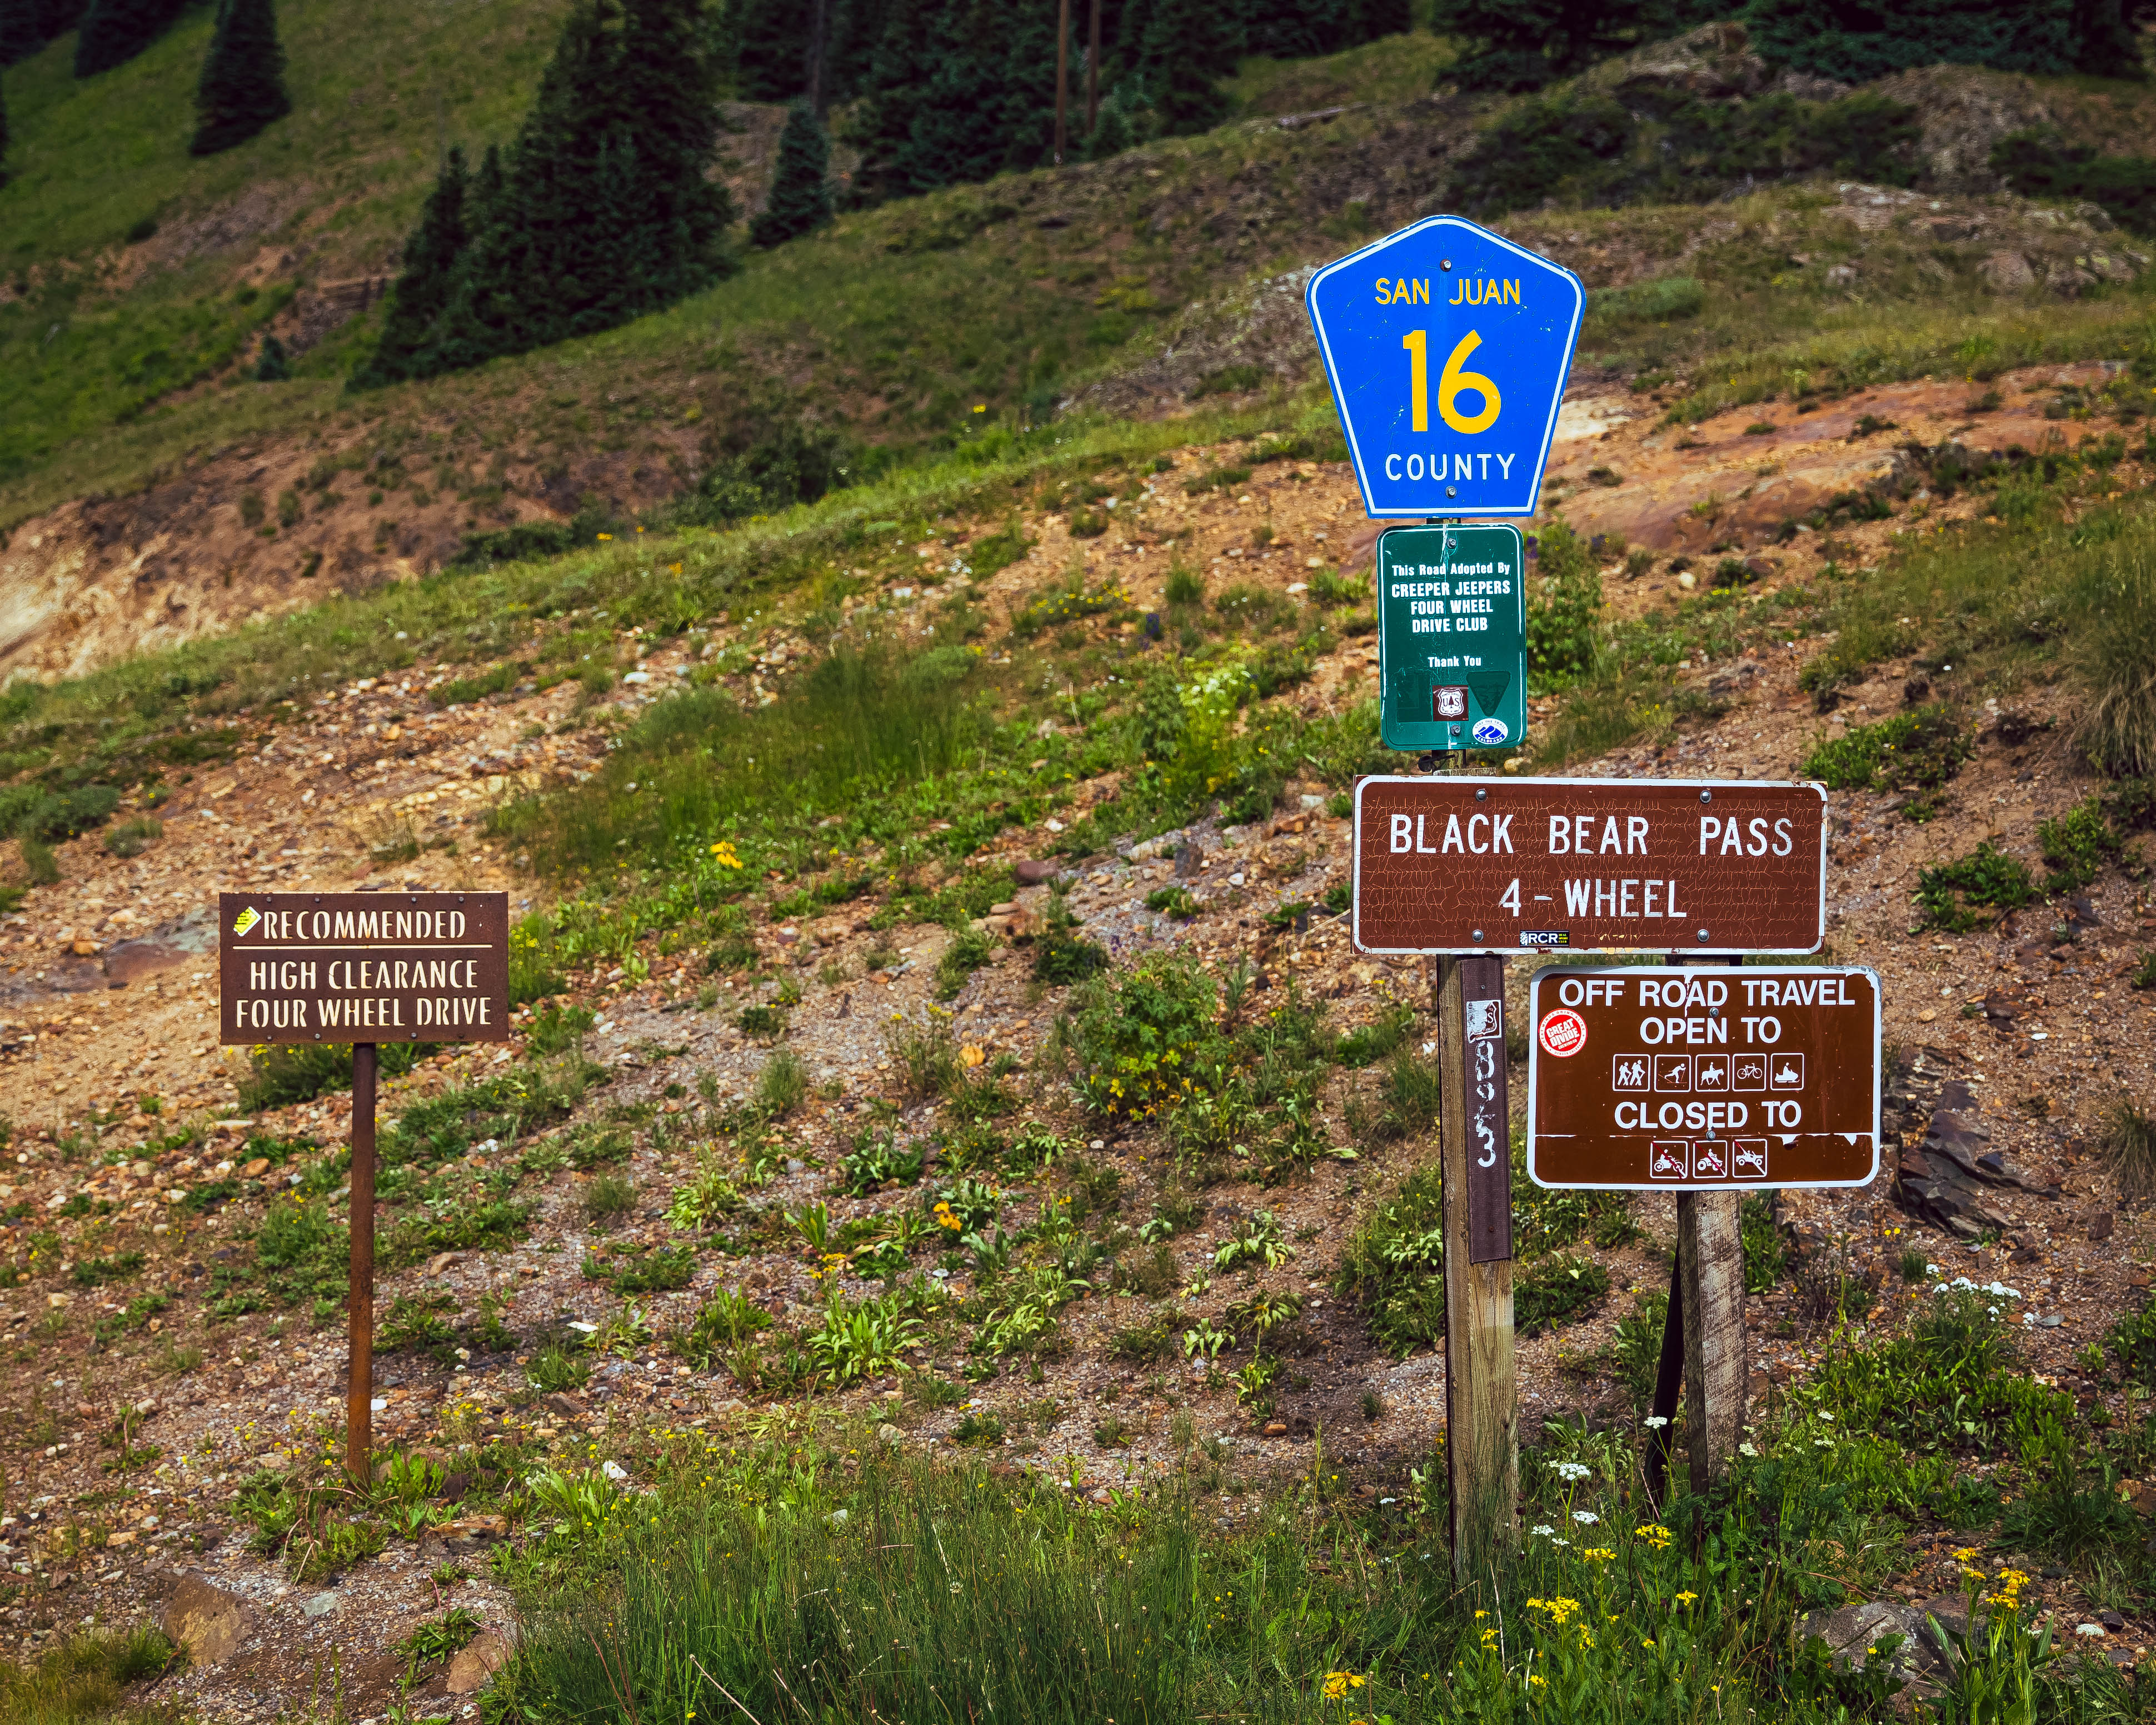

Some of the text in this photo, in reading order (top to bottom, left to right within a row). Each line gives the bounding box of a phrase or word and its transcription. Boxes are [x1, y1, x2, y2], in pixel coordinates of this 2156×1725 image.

[1376, 278, 1520, 305] SAN JUAN
[1403, 330, 1501, 434] 16
[1385, 453, 1515, 481] COUNTY
[1391, 562, 1510, 576] This Road Adopted By
[1391, 580, 1510, 598] CREEPER JEEPERS
[1410, 599, 1493, 615] FOUR WHEEL
[1412, 617, 1488, 633] DRIVE CLUB
[1428, 655, 1481, 667] Thank You
[1390, 813, 1793, 856] BLACK BEAR PASS
[264, 911, 465, 940] RECOMMENDED
[1528, 933, 1558, 944] RCR
[251, 960, 478, 990] HIGH CLEARANCE
[1559, 979, 1855, 1008] OFF ROAD TRAVEL
[237, 997, 491, 1028] FOUR WHEEL DRIVE
[1546, 1018, 1574, 1038] GREAT
[1549, 1027, 1580, 1047] DIVIDE
[1640, 1016, 1781, 1044] OPEN TO
[1614, 1100, 1801, 1129] CLOSED TO
